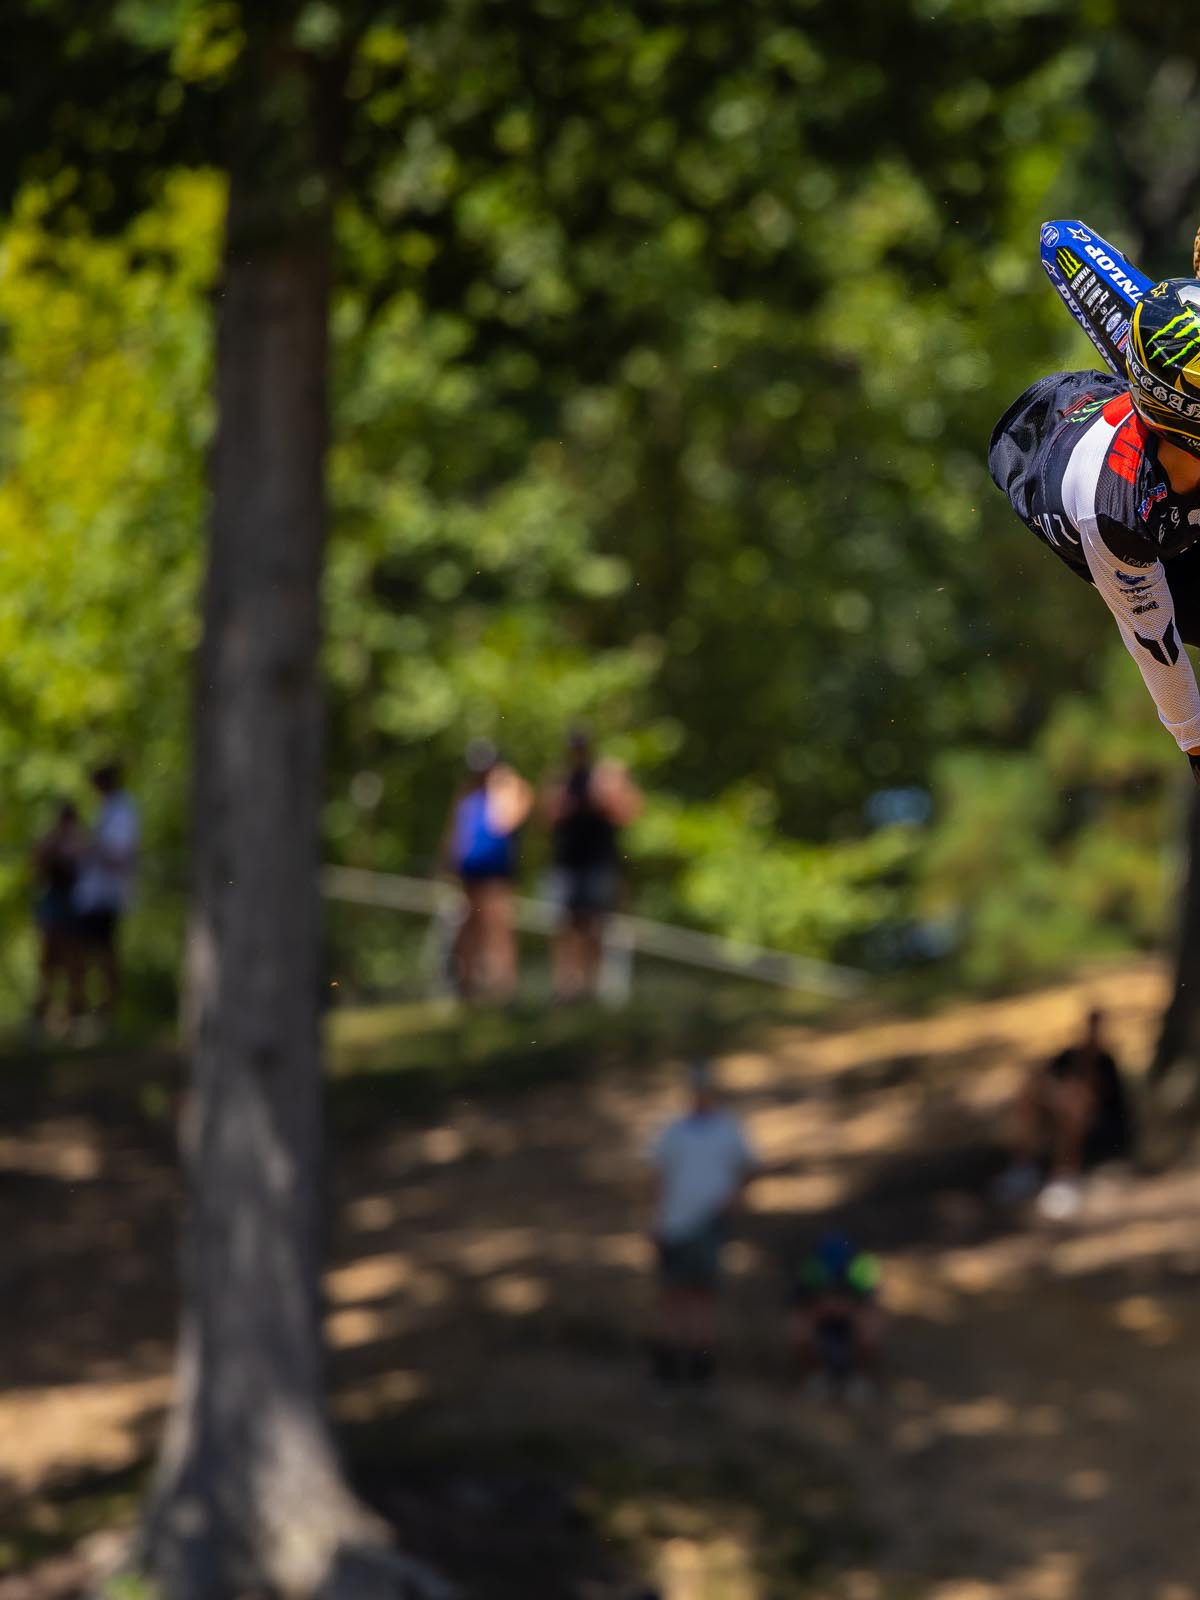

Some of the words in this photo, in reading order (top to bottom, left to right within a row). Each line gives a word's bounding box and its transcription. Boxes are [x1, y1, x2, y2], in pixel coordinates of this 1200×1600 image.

[1070, 266, 1092, 291] YAMAHA
[1085, 245, 1143, 303] UNLOP
[1057, 283, 1118, 372] DUNLOP
